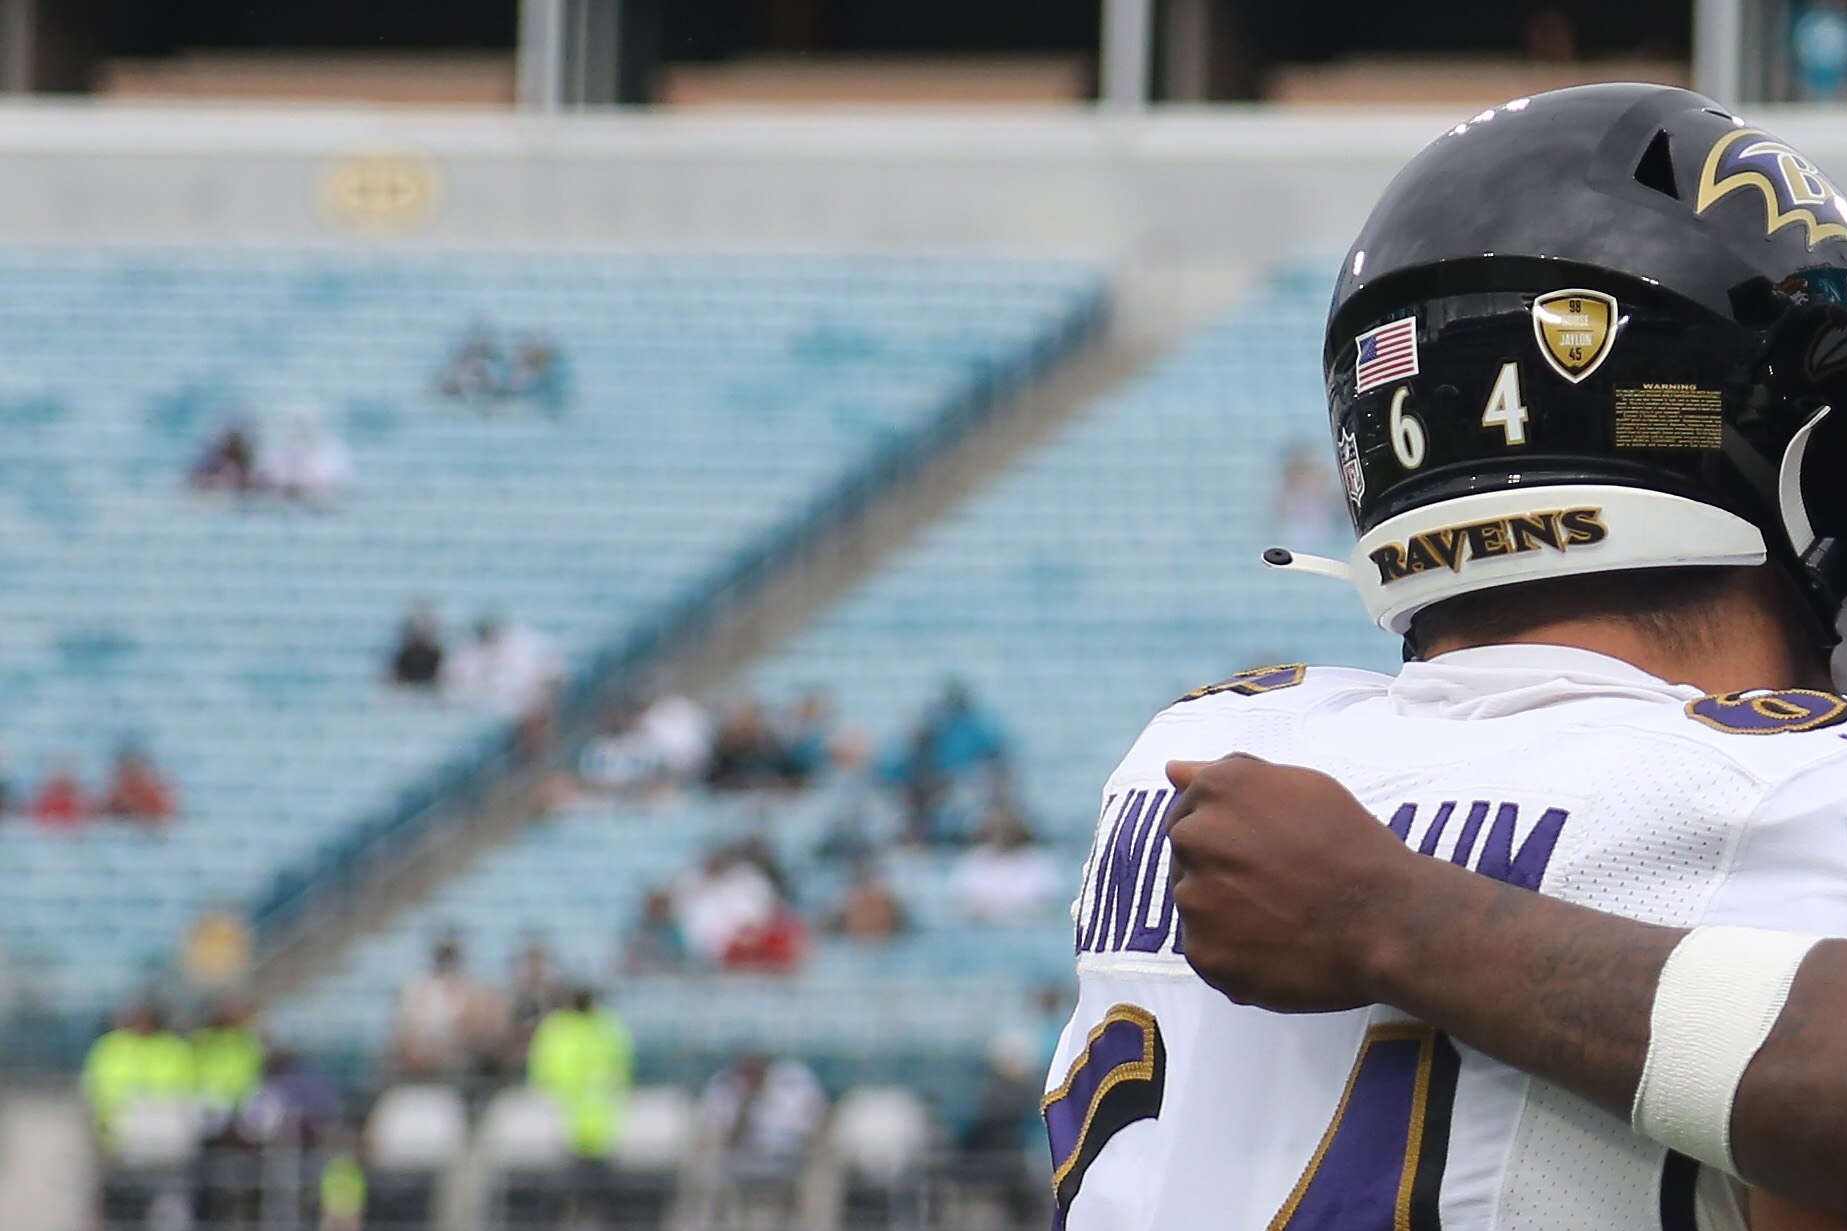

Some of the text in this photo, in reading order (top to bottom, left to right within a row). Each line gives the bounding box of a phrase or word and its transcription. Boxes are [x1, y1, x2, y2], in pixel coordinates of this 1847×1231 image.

[1569, 300, 1582, 313] 98
[1559, 334, 1593, 346] JAYLON
[1569, 347, 1582, 361] 45
[1389, 386, 1424, 469] 6
[1482, 362, 1529, 445] 4
[1368, 505, 1608, 586] RAVENS
